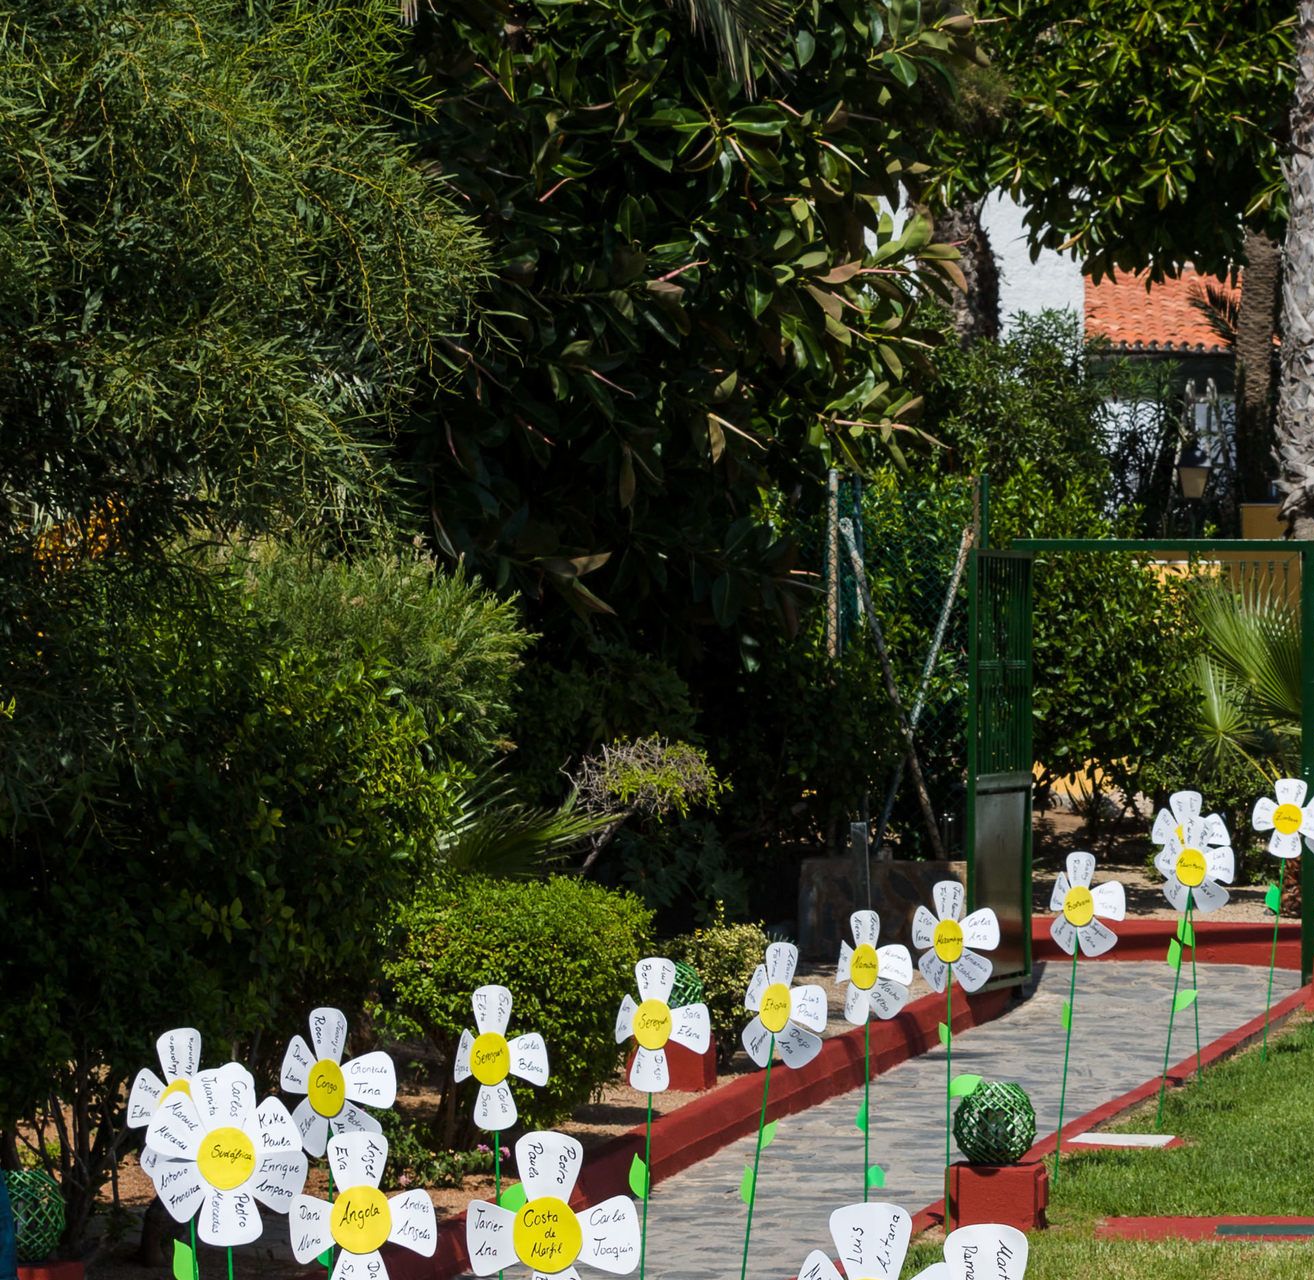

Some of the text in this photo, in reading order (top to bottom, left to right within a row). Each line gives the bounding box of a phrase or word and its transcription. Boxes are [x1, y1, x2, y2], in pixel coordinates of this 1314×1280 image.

[350, 1062, 388, 1075] Gonzalo
[315, 1074, 338, 1095] Congo
[354, 1082, 381, 1095] Tina
[230, 1081, 247, 1117] Carlos
[165, 1102, 198, 1131] Manuel
[261, 1132, 291, 1148] Paula
[211, 1144, 252, 1164] Sudáfrica
[335, 1146, 349, 1170] Eva
[528, 1142, 544, 1179] Paula
[259, 1158, 300, 1180] Enrique
[556, 1145, 577, 1185] Pedro
[160, 1168, 188, 1191] Antonio
[255, 1179, 294, 1198] Amparo
[234, 1193, 250, 1228] Pedro
[300, 1204, 321, 1221] Dani
[339, 1200, 380, 1230] Angola
[400, 1197, 429, 1214] Andrés
[474, 1208, 504, 1232] Javier
[523, 1209, 559, 1228] Costa
[589, 1208, 626, 1226] Carlos
[544, 1227, 556, 1239] de
[475, 1241, 498, 1256] Ana
[530, 1241, 563, 1260] Marfil
[846, 1227, 864, 1265] Luis
[876, 1214, 900, 1274] Aitana
